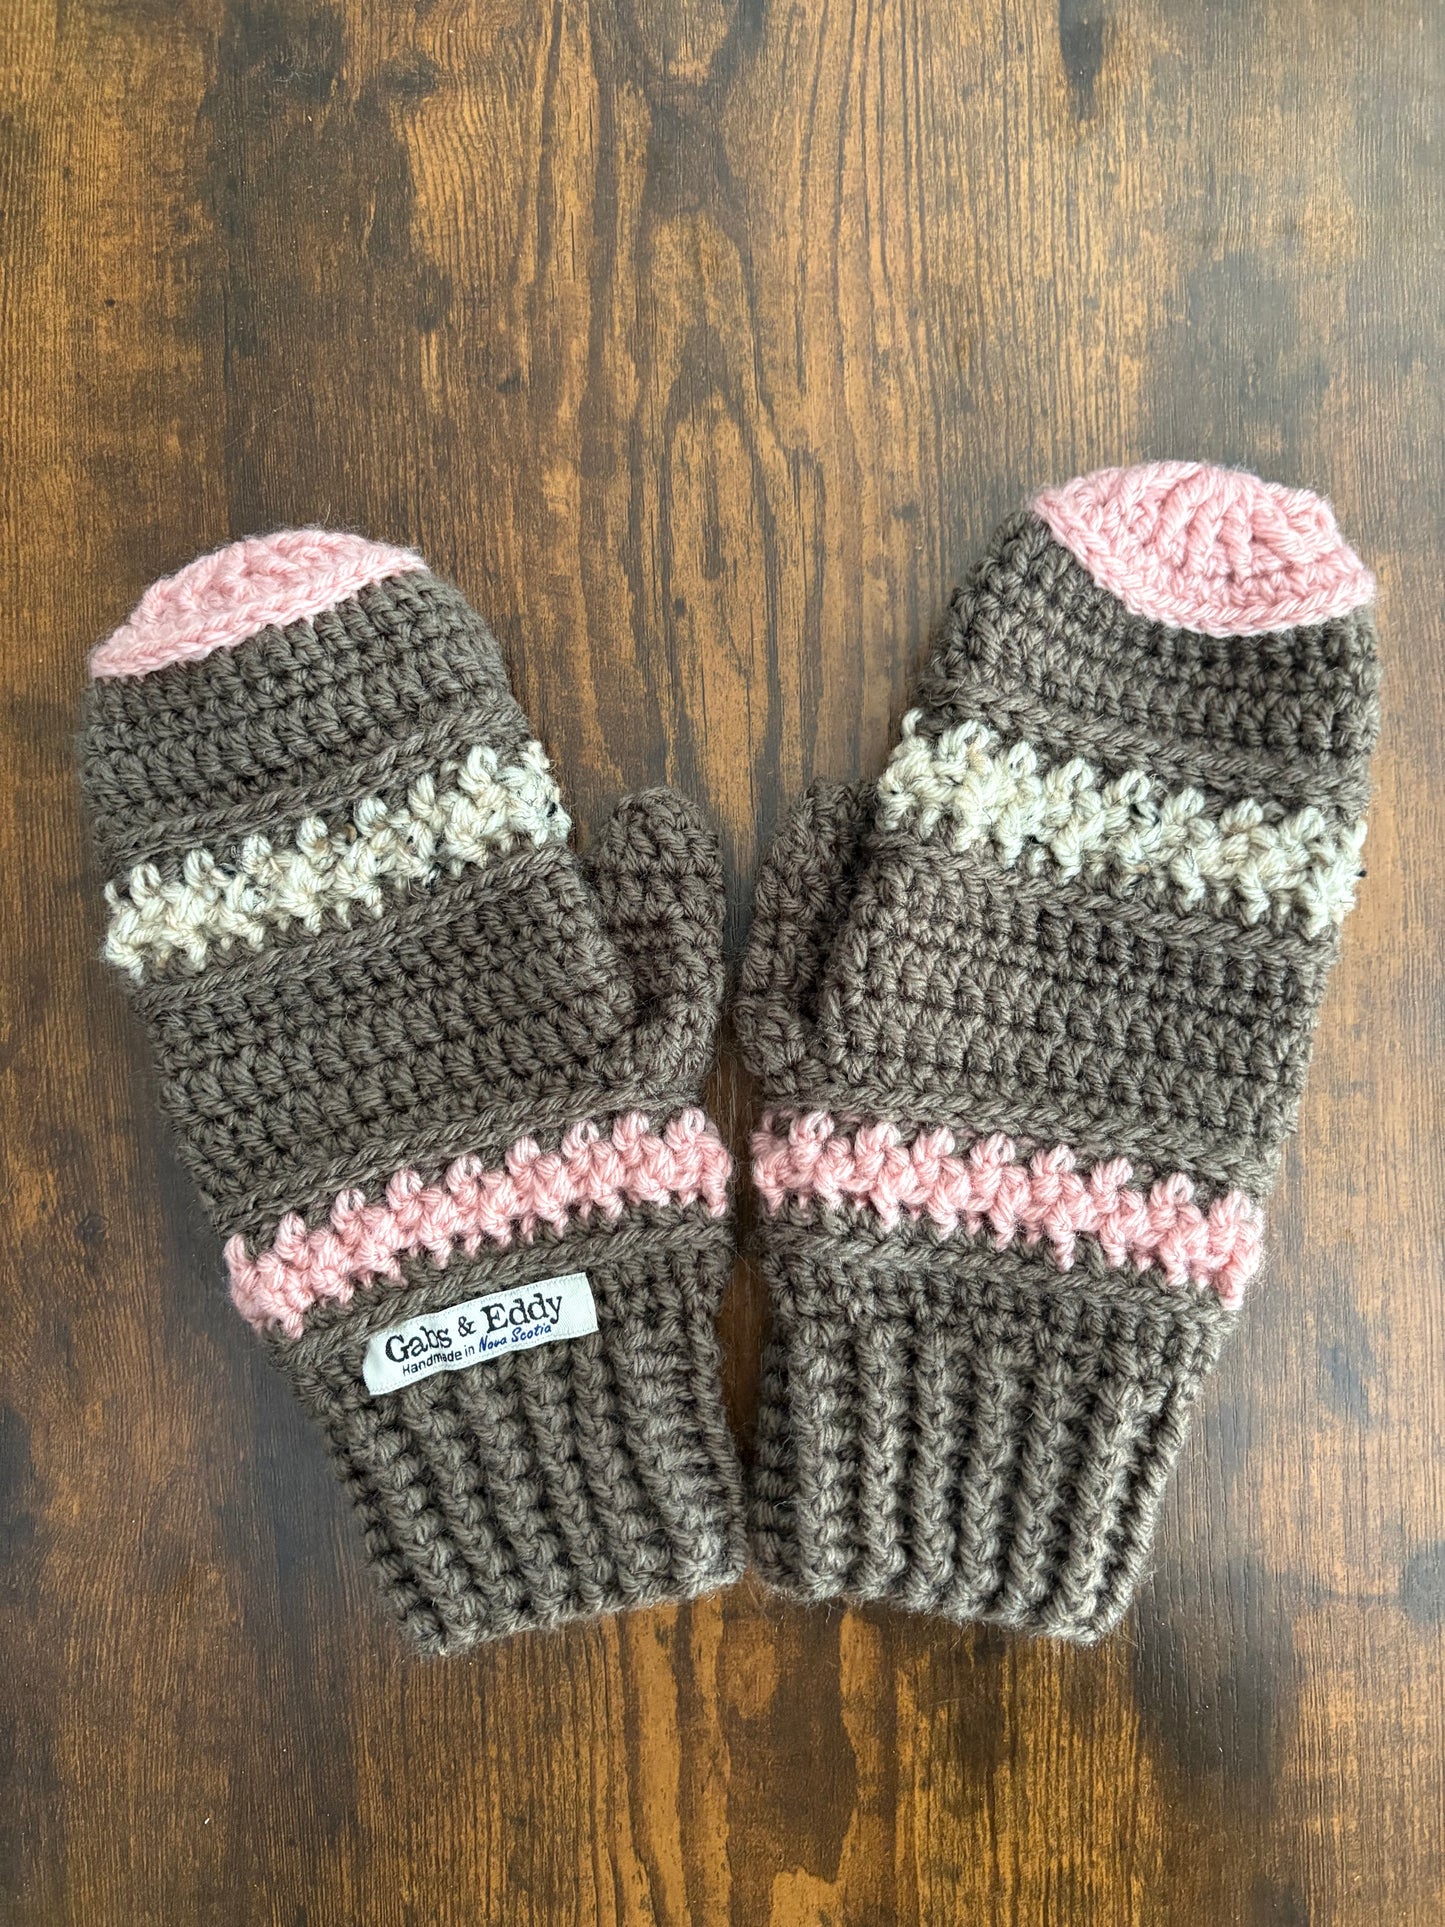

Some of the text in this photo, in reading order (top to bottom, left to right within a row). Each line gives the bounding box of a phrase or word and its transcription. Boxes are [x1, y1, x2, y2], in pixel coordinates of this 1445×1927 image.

[385, 1292, 563, 1363] Gabs & Eddy
[402, 1323, 552, 1377] Handmade in Nova Scotia
